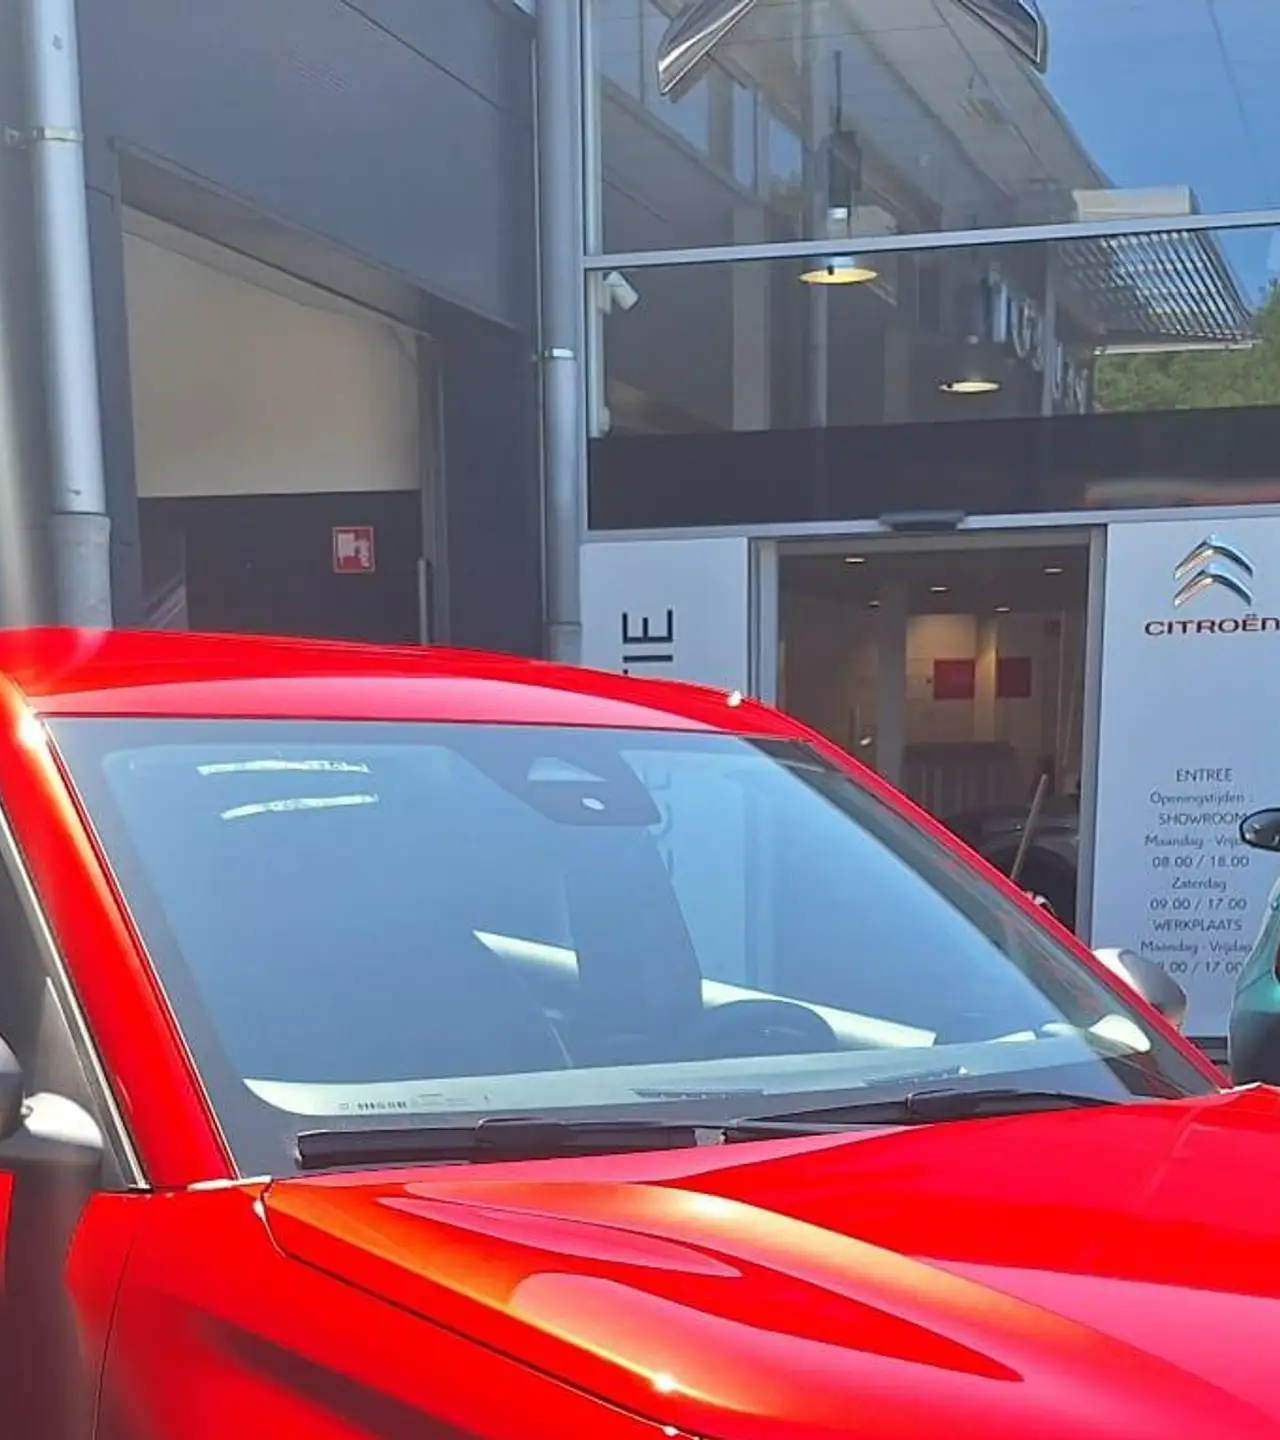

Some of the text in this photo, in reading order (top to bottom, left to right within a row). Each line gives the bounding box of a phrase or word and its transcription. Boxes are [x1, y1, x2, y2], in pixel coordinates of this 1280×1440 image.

[1144, 613, 1280, 636] CITROËN
[1176, 768, 1233, 782] ENTREE
[1171, 876, 1227, 893] Zaterdag
[1152, 919, 1243, 932] WERKPLAATS
